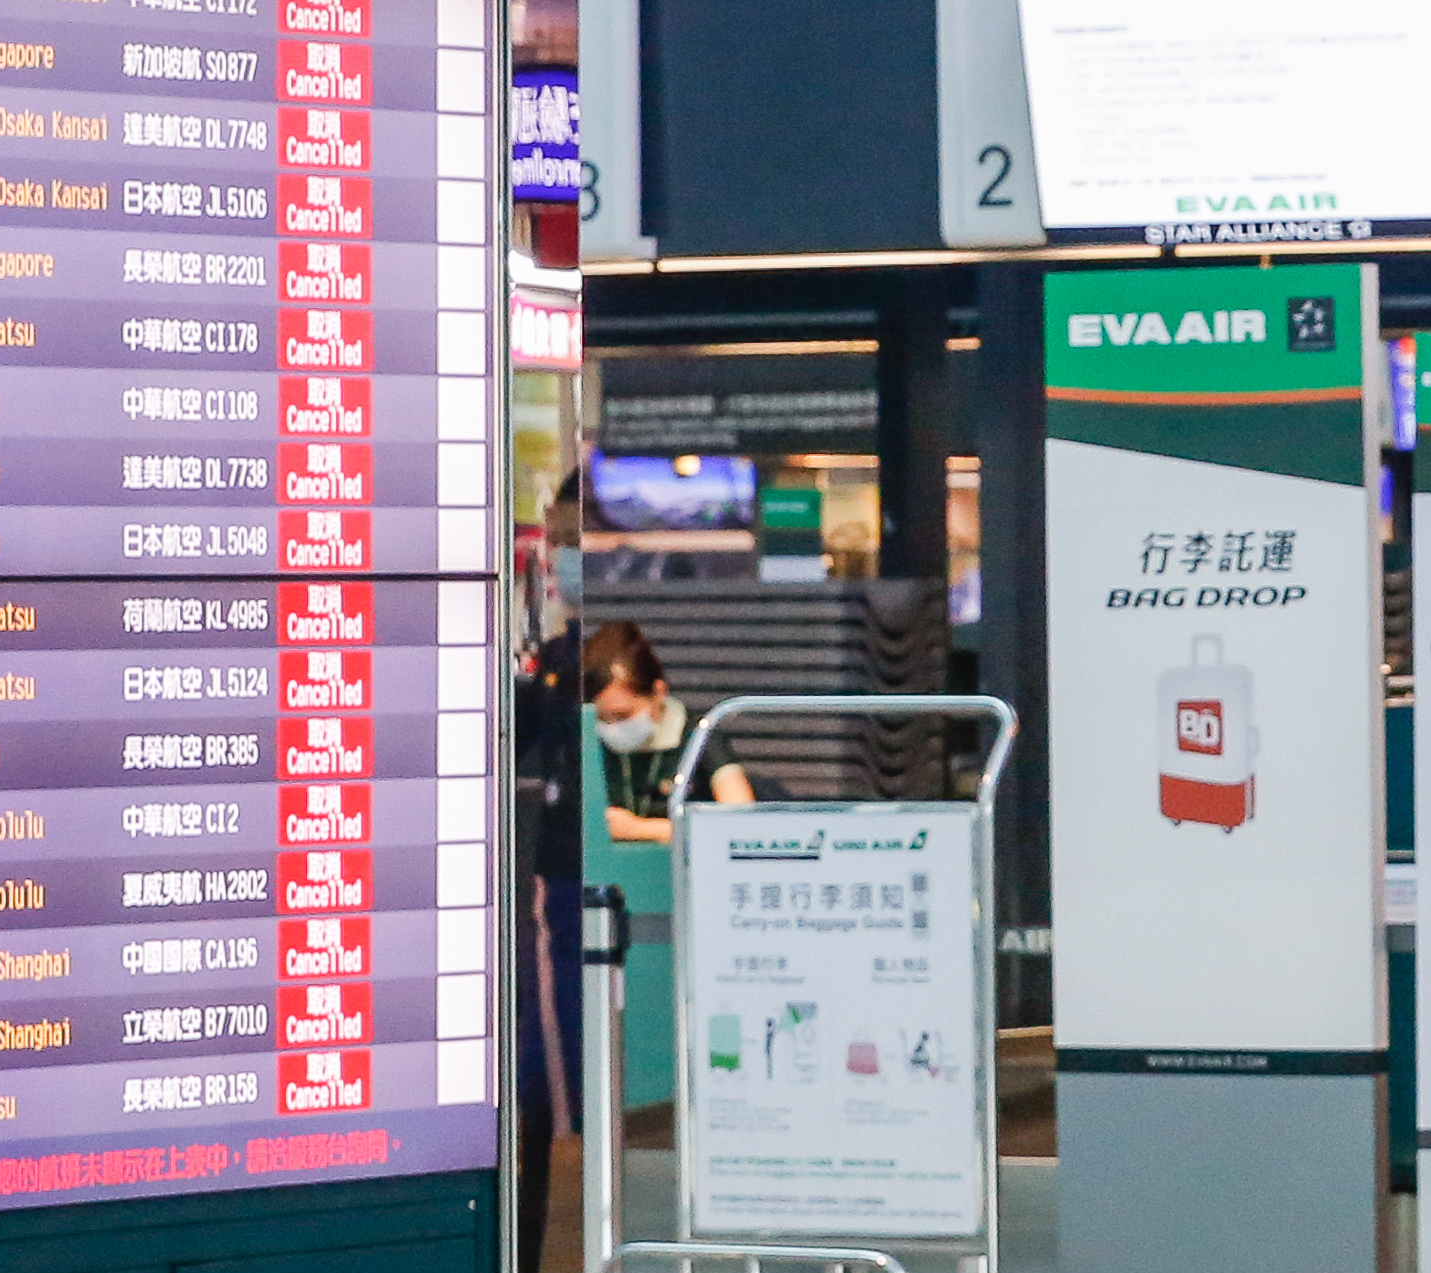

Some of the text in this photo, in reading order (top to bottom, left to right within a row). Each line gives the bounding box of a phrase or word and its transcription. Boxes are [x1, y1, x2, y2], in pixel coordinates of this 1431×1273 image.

[977, 145, 1014, 209] 2
[1175, 191, 1339, 214] EVA AIR
[1144, 219, 1343, 244] STAR ALLIANCE
[1068, 309, 1267, 348] EVA AIR
[285, 339, 361, 367] Cancelled
[1139, 530, 1298, 577] 行李託運
[1106, 585, 1308, 608] BAG DROP
[285, 948, 361, 977] Cancelled
